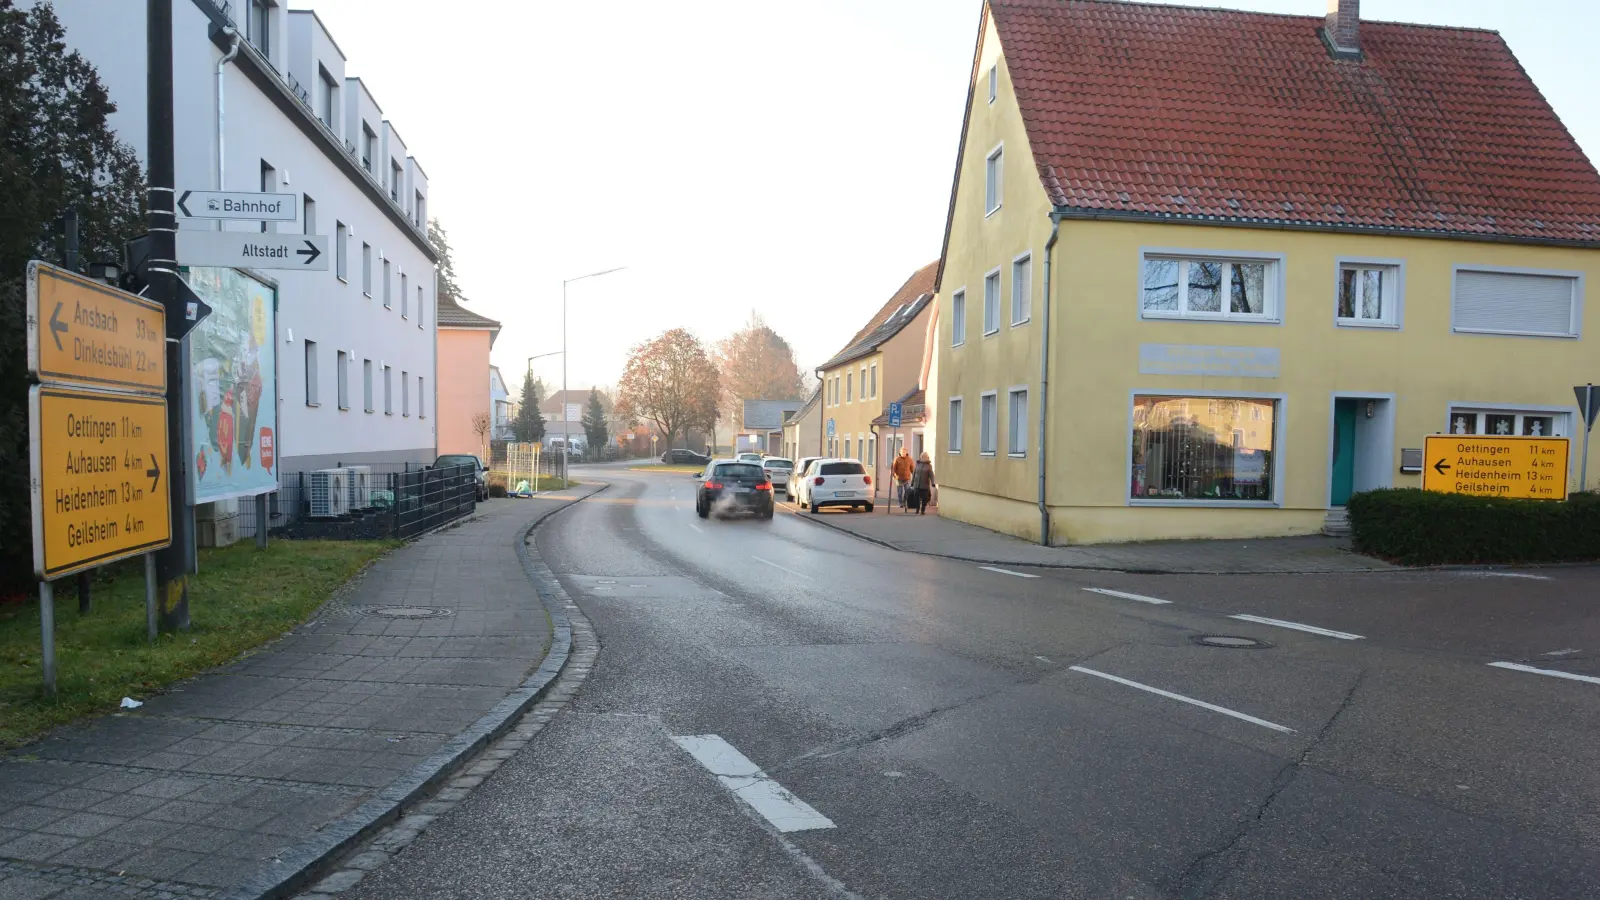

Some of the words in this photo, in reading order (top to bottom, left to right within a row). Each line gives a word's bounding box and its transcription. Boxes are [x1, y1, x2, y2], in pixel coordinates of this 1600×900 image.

[223, 198, 282, 213] Bahnhof
[242, 243, 289, 258] Altstadt
[73, 300, 118, 334] Ansbach
[135, 317, 146, 340] 33
[73, 337, 132, 370] Dinkelsbühl
[136, 351, 147, 372] 22
[67, 413, 117, 444] Oettingen
[121, 416, 130, 437] 11
[131, 422, 143, 438] km
[1457, 443, 1510, 456] Oettingen
[1529, 445, 1539, 455] 11
[1541, 447, 1555, 455] km
[66, 450, 117, 475] Auhausen
[124, 449, 130, 470] 4
[131, 454, 143, 470] km
[1457, 457, 1512, 467] Auhausen
[1531, 459, 1539, 468] 4
[1541, 460, 1554, 468] km
[1456, 470, 1521, 481] Heidenheim
[1526, 472, 1538, 481] 13
[1540, 473, 1553, 481] km
[55, 484, 118, 514] Heidenheim
[121, 481, 130, 503] 13
[132, 484, 144, 500] km
[1455, 482, 1510, 493] Geilsheim
[1530, 485, 1537, 494] 4
[1539, 486, 1553, 494] km
[68, 518, 118, 548] Geilsheim
[125, 513, 131, 534] 4
[132, 518, 144, 533] km
